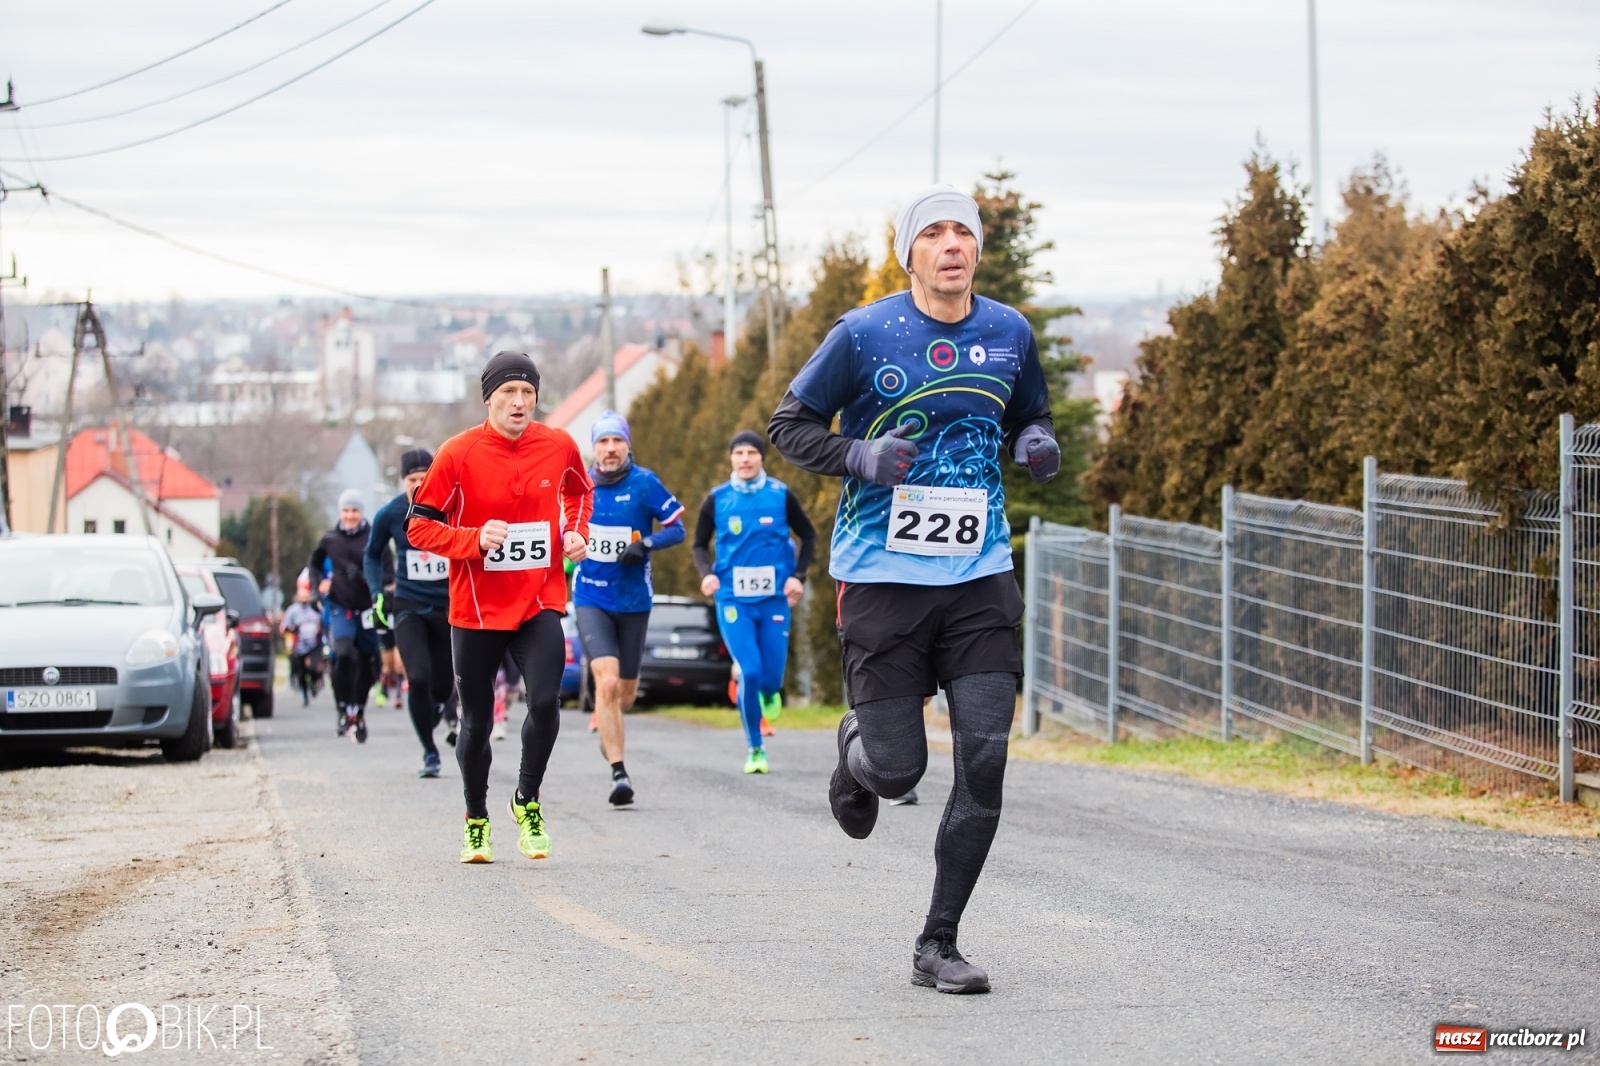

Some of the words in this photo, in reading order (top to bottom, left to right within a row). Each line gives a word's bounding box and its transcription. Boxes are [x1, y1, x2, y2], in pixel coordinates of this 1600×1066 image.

[894, 510, 979, 544] 228
[489, 540, 546, 562] 355
[588, 537, 627, 555] 388
[411, 561, 446, 574] 118
[738, 578, 772, 590] 152
[17, 690, 50, 708] SZO
[56, 690, 91, 706] 08G1
